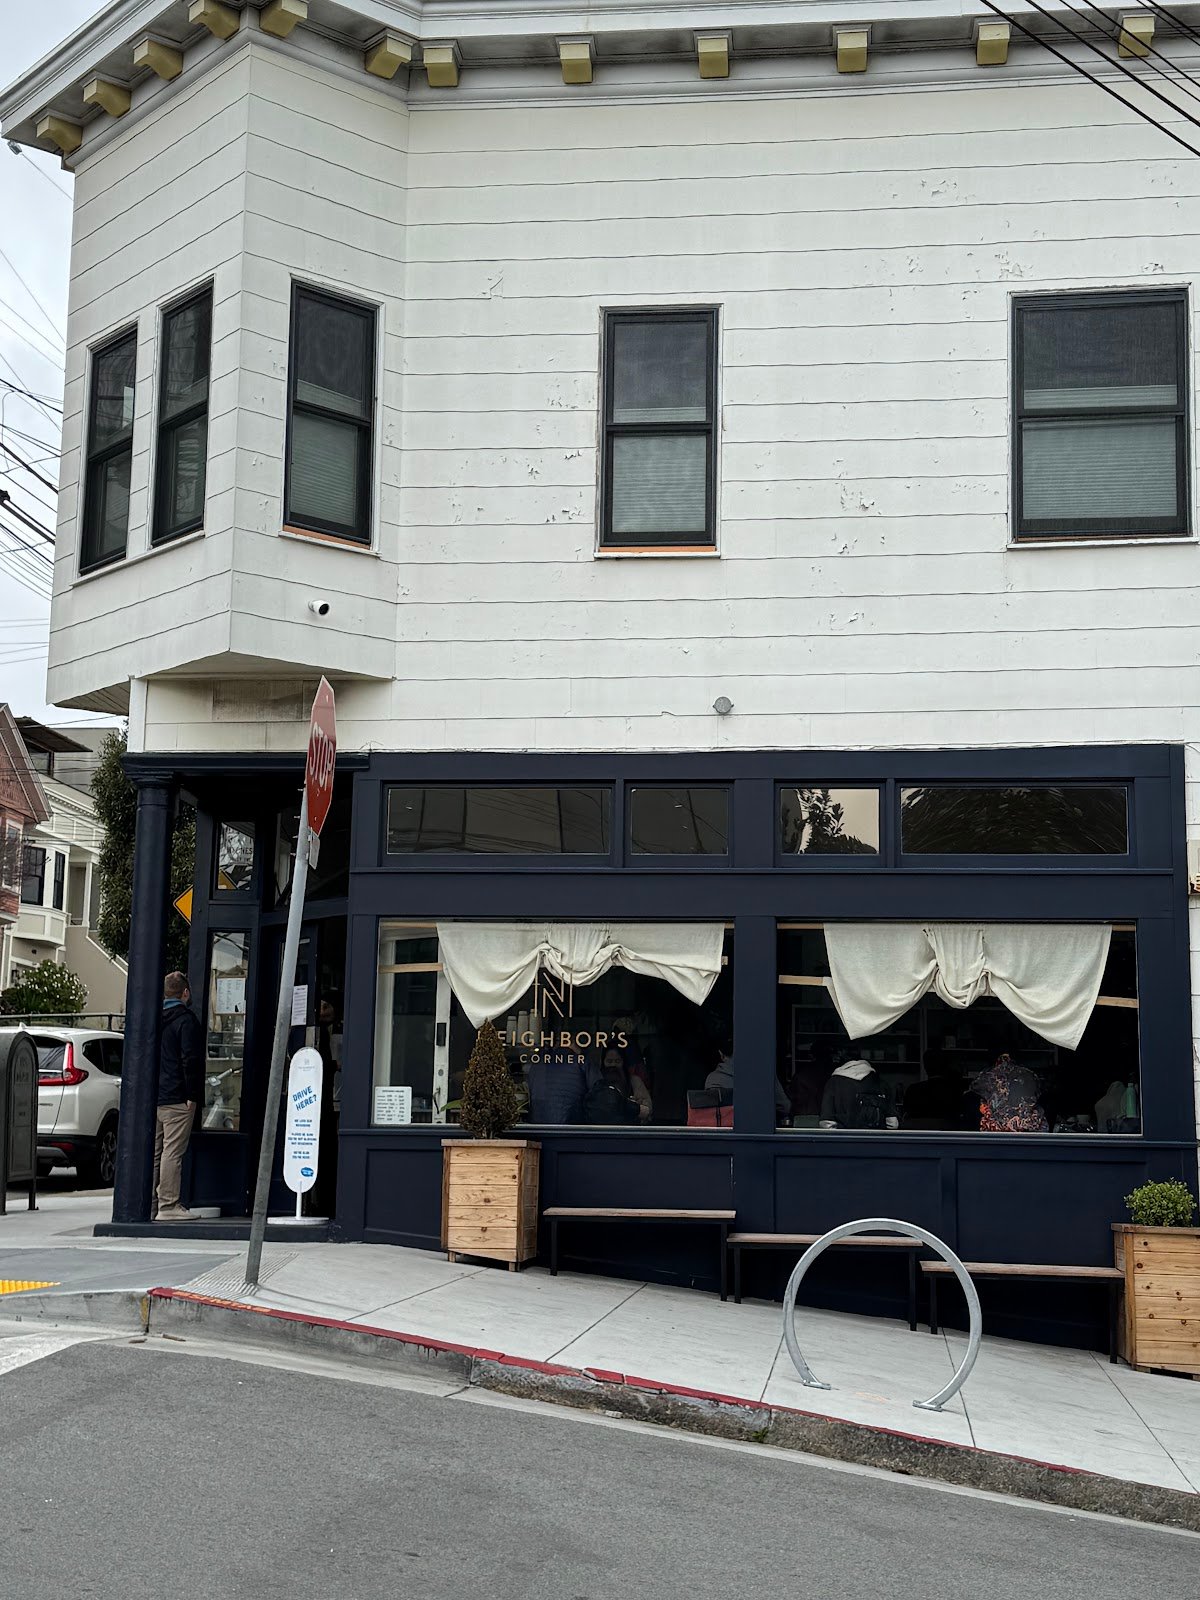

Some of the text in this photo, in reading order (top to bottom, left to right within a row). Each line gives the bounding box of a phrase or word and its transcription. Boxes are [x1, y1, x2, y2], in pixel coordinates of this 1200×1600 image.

[310, 721, 334, 791] STOP
[477, 1030, 629, 1048] EIGHBOR'S
[519, 1053, 585, 1064] CORNER
[292, 1085, 312, 1101] DRIVE
[295, 1094, 317, 1111] HERE?
